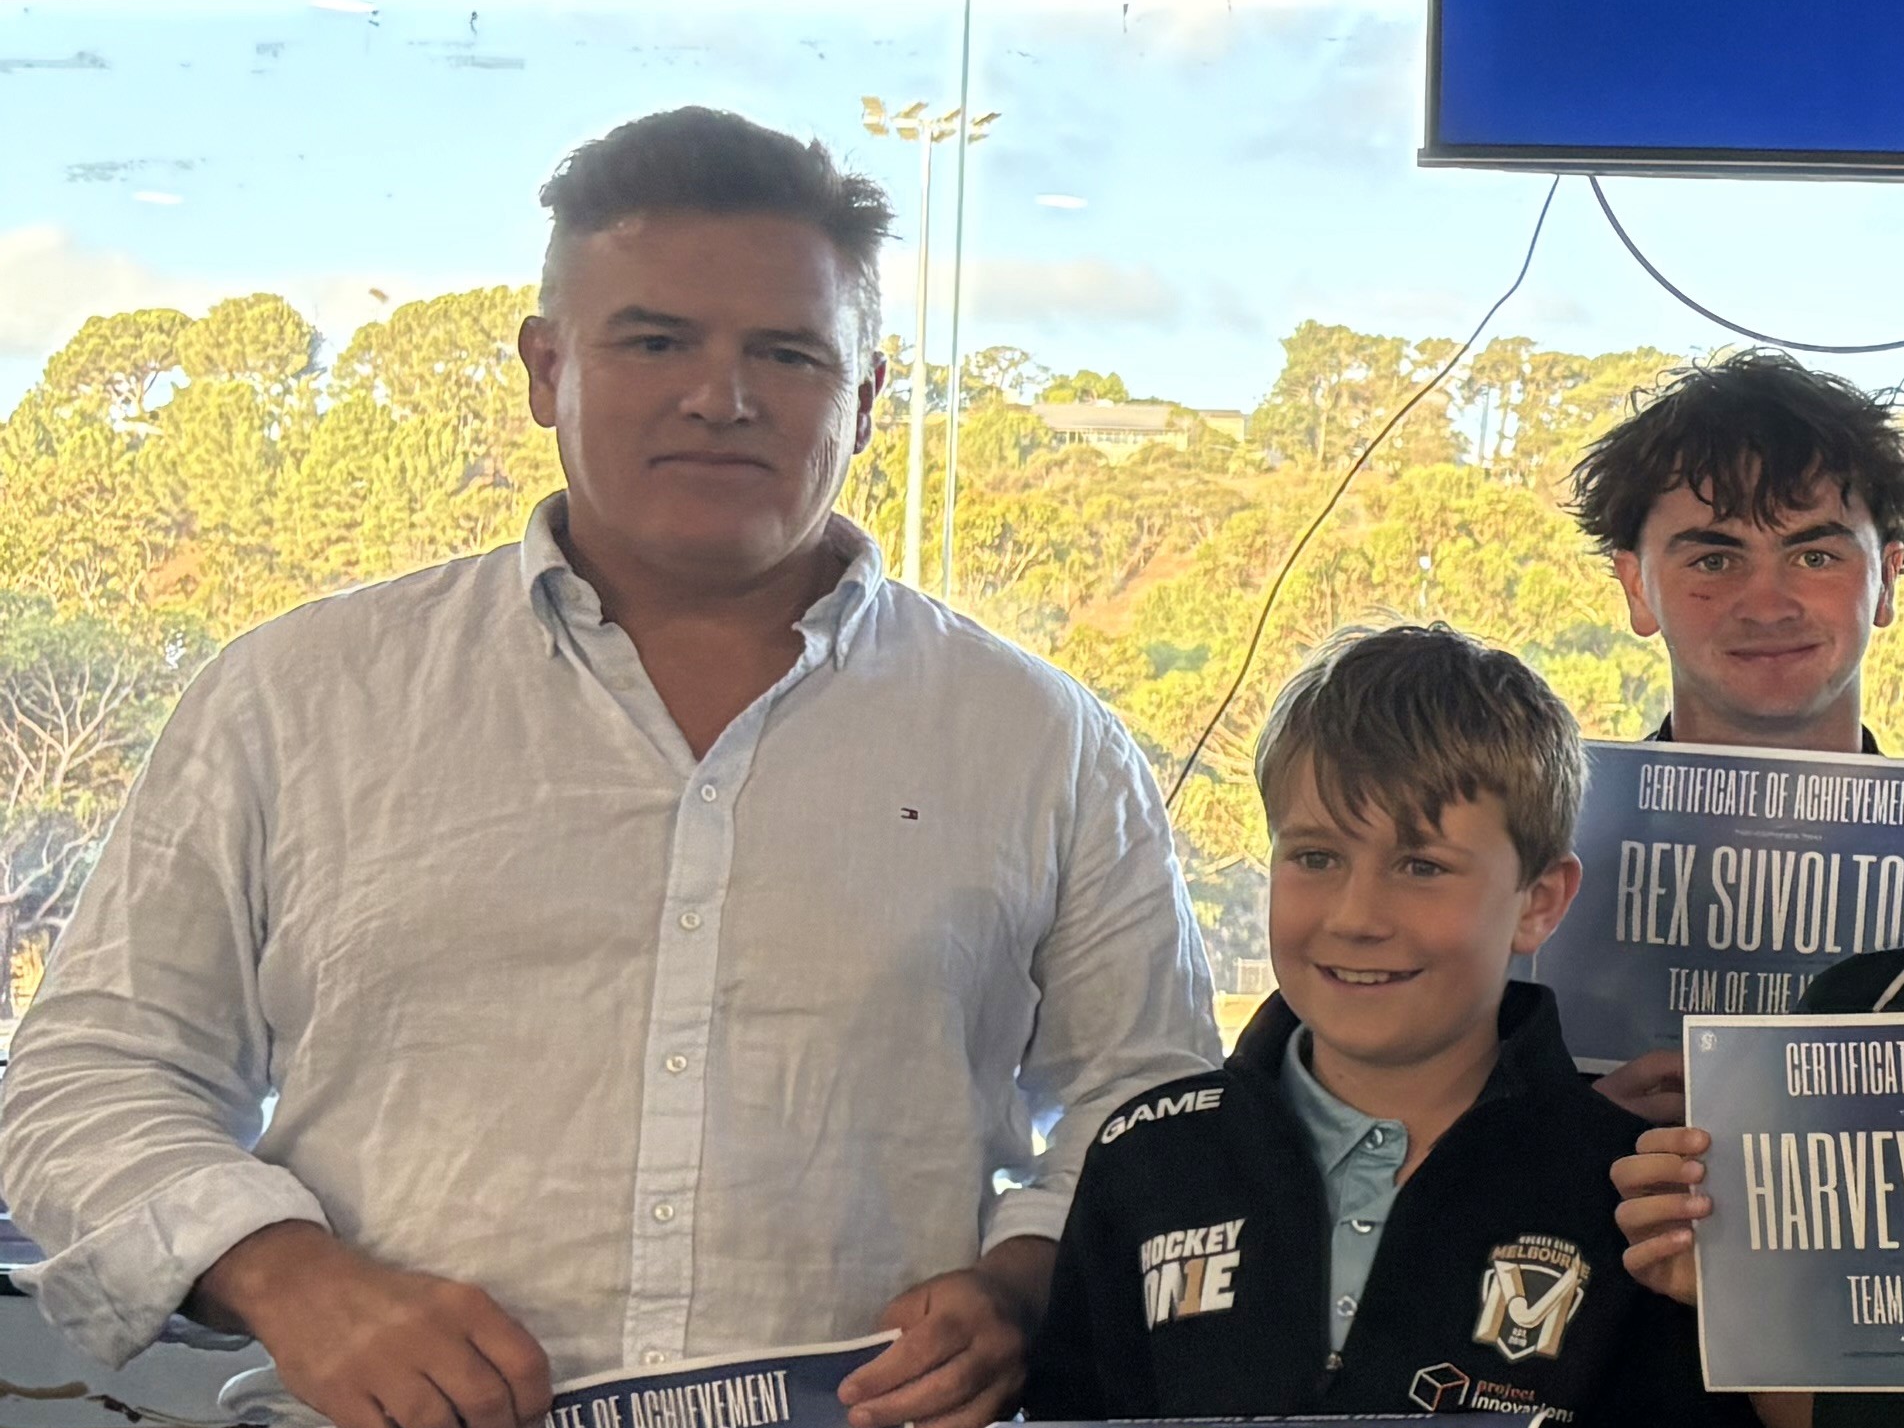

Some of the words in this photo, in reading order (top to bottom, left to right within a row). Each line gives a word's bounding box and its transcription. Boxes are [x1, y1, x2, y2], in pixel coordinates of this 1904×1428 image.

[1638, 764, 1759, 818] CERTIFICATE
[1764, 774, 1789, 820] OF
[1616, 840, 1697, 947] REX
[1100, 1087, 1225, 1144] GAME
[1140, 1217, 1247, 1274] HOCKEY
[1477, 1380, 1536, 1402] project
